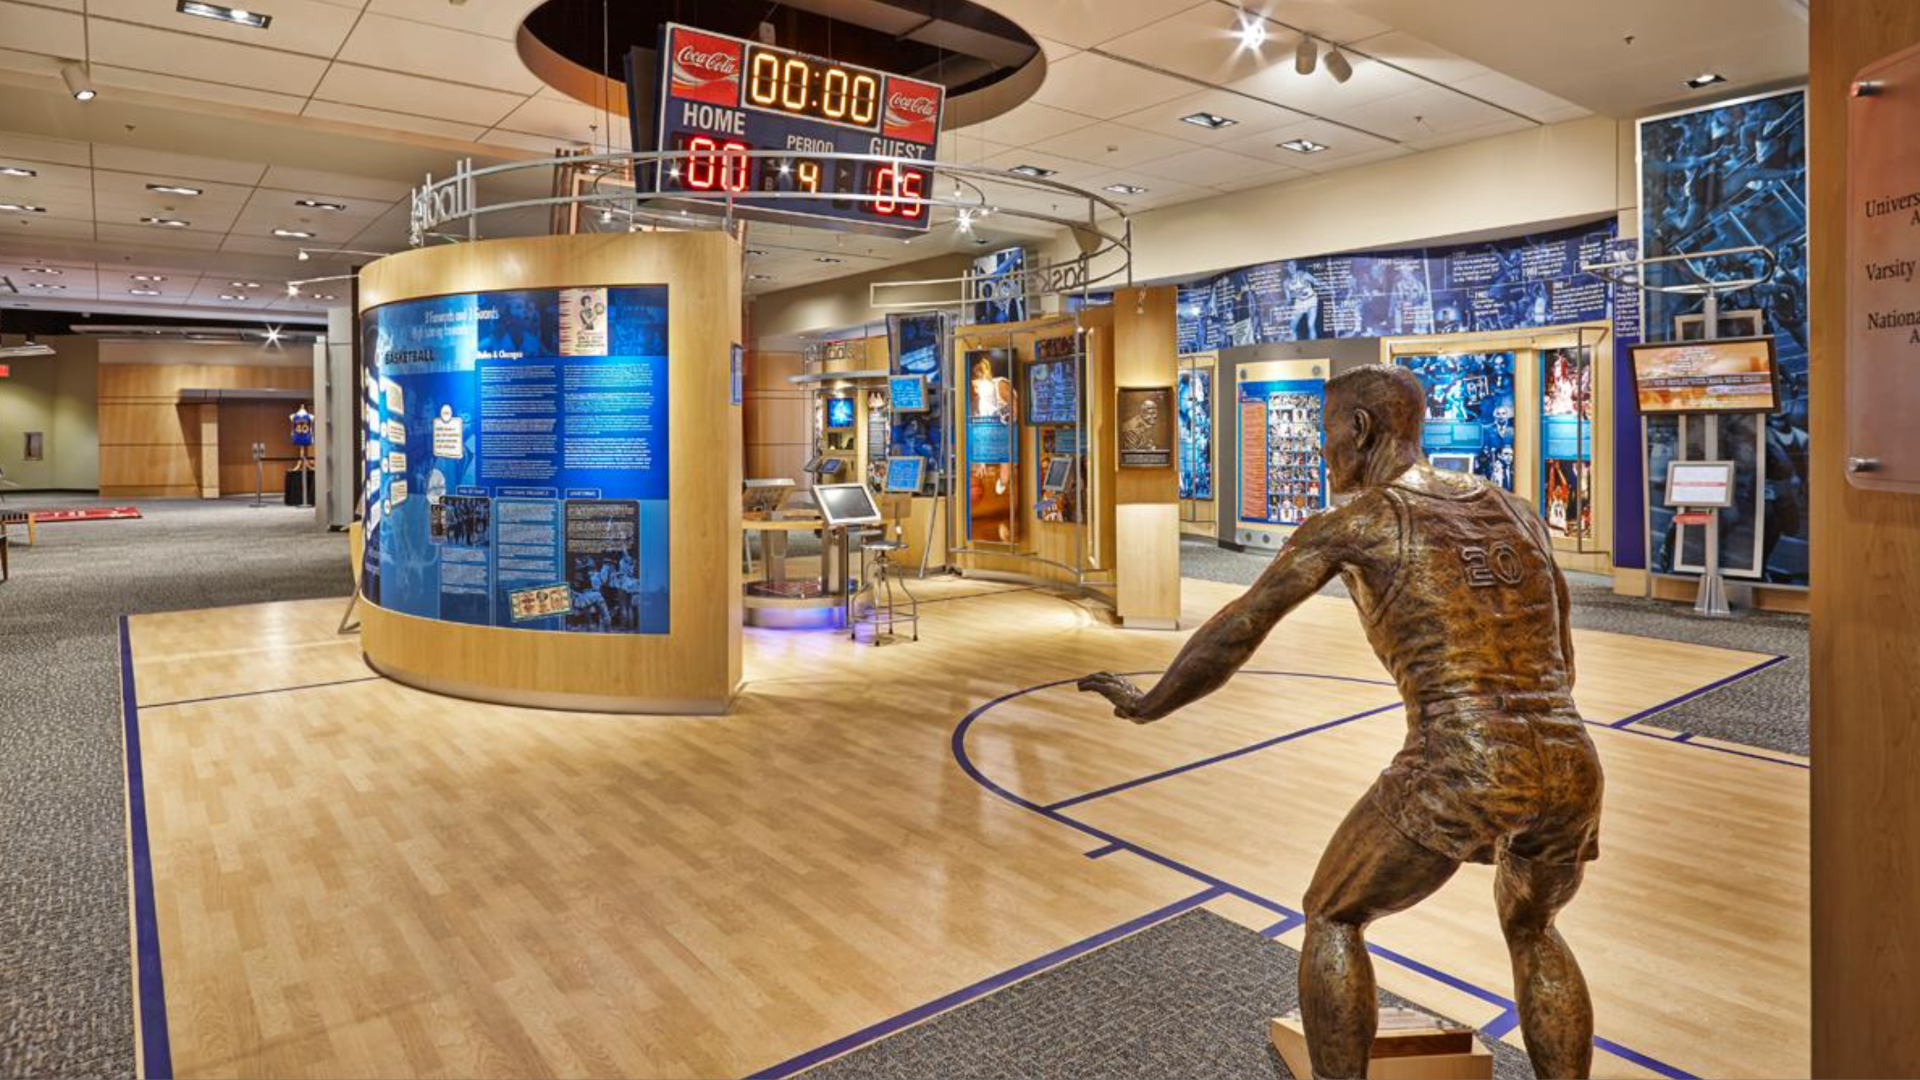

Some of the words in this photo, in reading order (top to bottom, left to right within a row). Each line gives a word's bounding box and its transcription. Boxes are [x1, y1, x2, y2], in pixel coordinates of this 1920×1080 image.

[752, 53, 875, 122] 00:00
[683, 103, 746, 135] HOME
[786, 135, 835, 153] PERIOD
[869, 137, 926, 160] GUEST
[688, 137, 747, 191] 00
[799, 163, 818, 196] 4
[876, 168, 922, 216] 05
[1865, 258, 1916, 283] Varsity
[385, 349, 434, 365] BASKETBALL
[1461, 542, 1523, 588] 20
